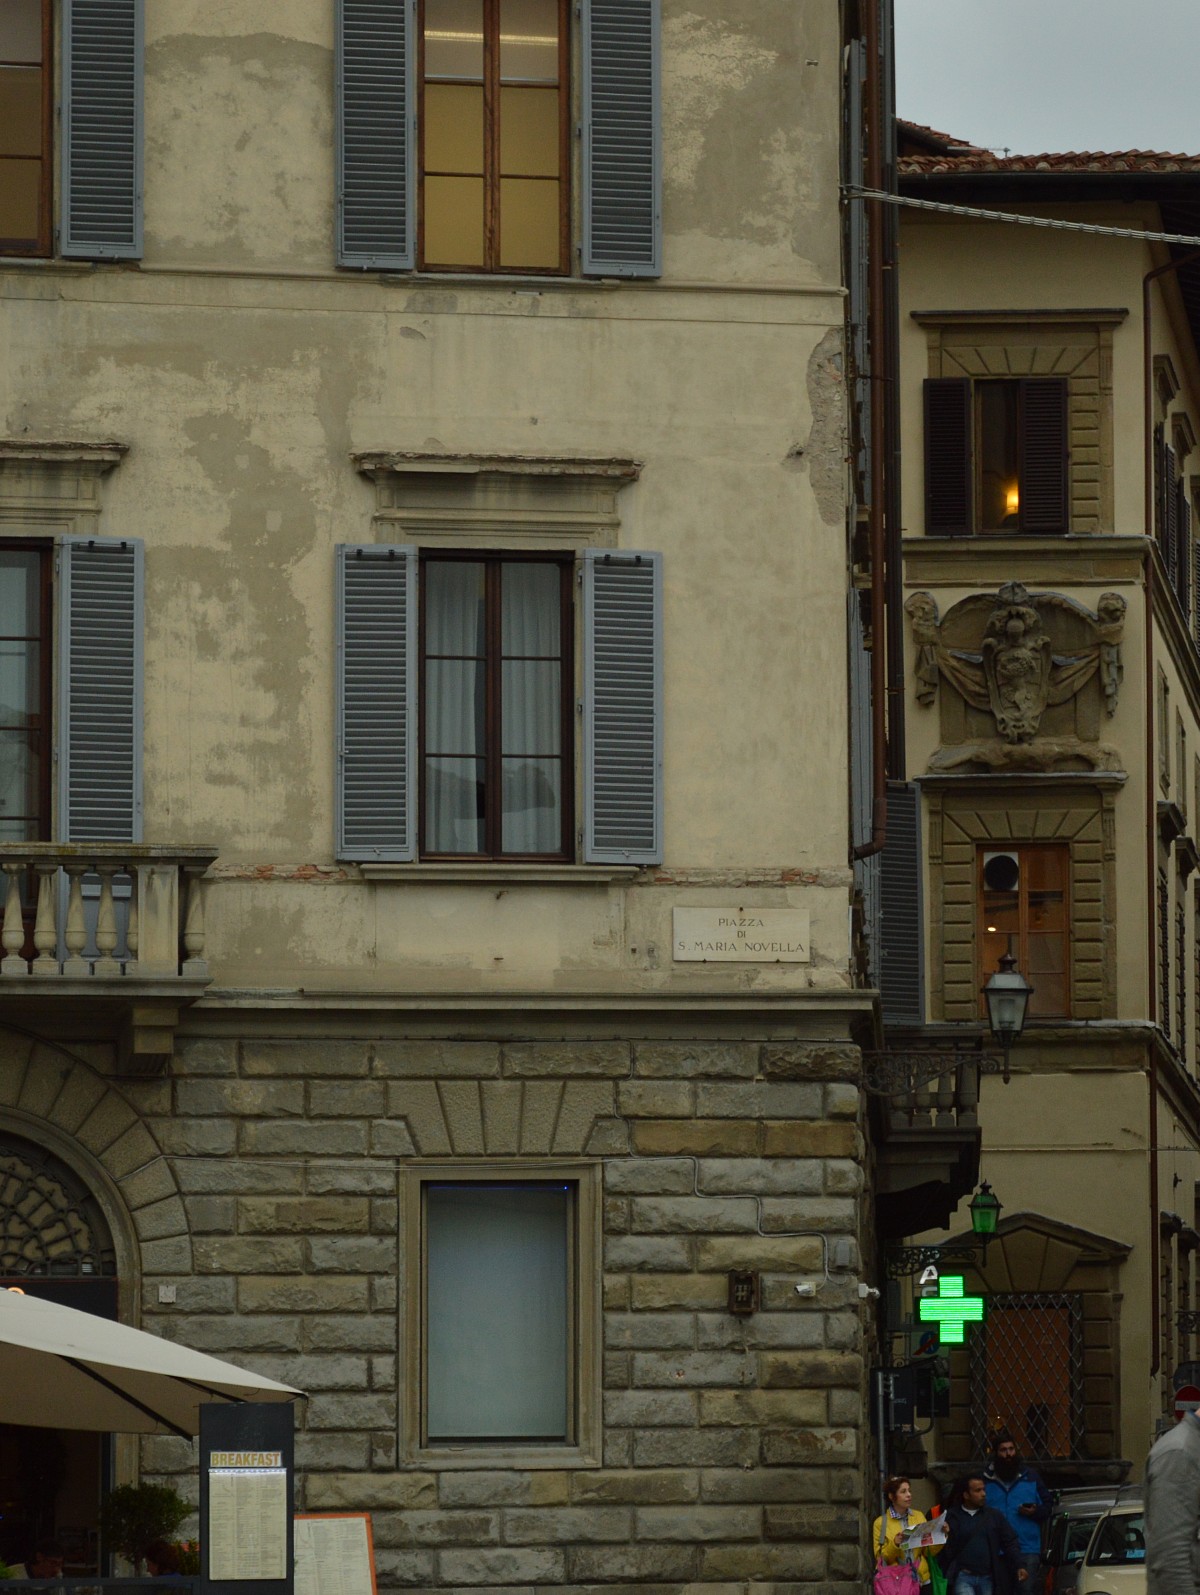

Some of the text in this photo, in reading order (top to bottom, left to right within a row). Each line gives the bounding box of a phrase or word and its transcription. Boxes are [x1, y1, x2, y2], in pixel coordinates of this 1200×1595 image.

[718, 918, 764, 927] PIAZZA
[737, 930, 746, 939] DI
[745, 942, 805, 953] NOVELLA
[211, 1453, 280, 1466] BREAKFAST
